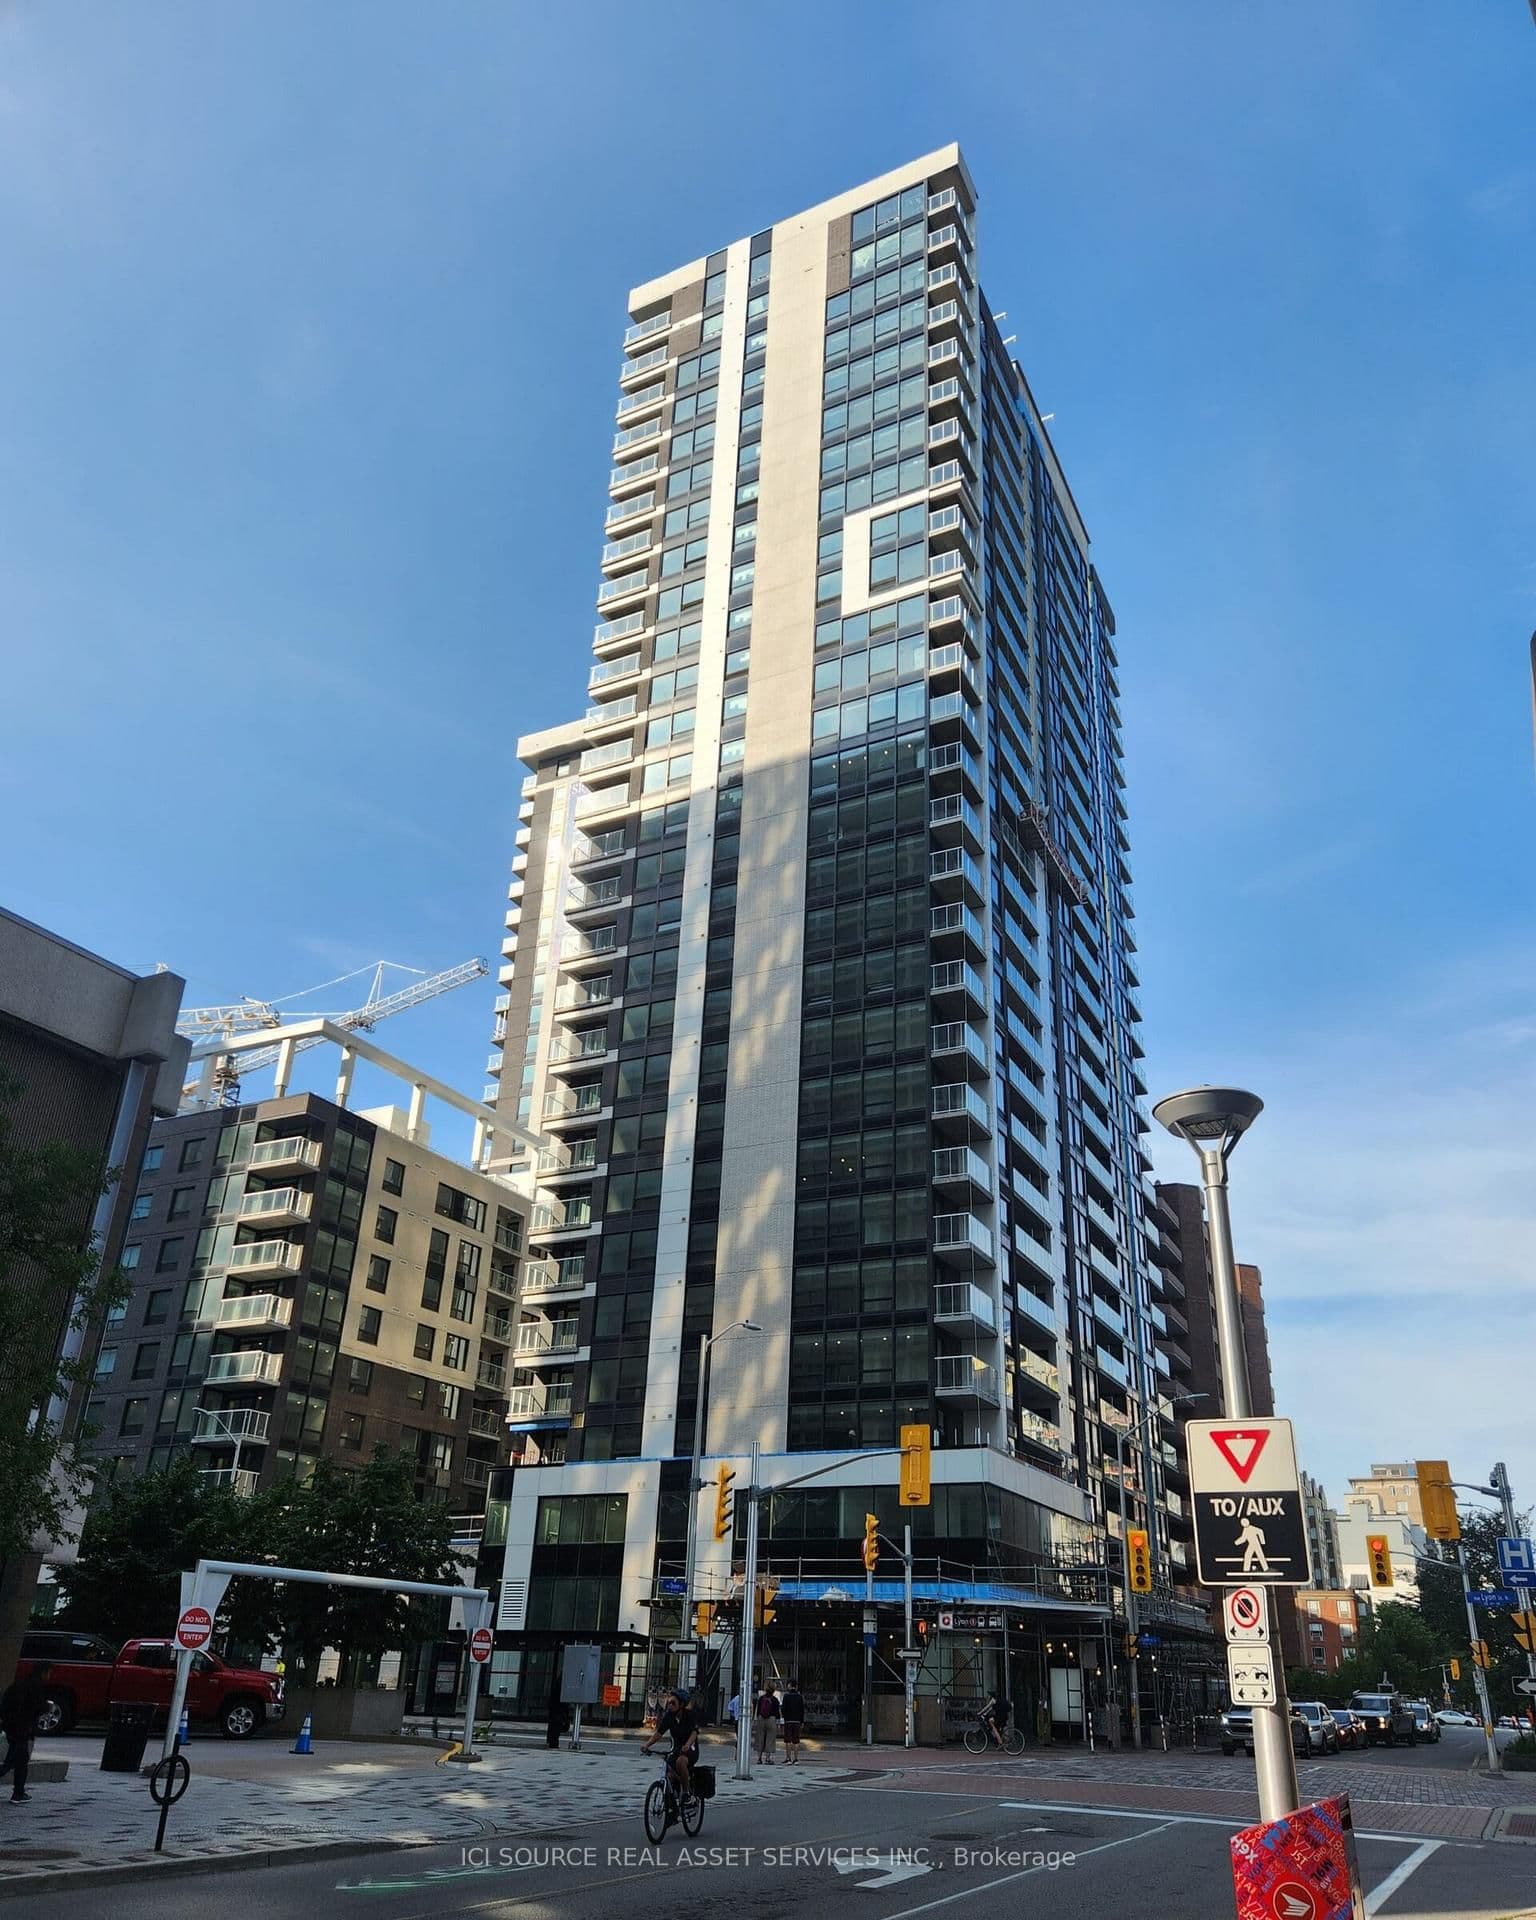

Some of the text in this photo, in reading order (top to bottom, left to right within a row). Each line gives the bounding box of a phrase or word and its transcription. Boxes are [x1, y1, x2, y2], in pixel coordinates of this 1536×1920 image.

[1208, 1496, 1286, 1518] TO/AUX
[1502, 1540, 1530, 1568] H
[184, 1615, 195, 1623] DO
[183, 1632, 204, 1641] ENTER
[1230, 1836, 1258, 1865] H9X
[1290, 1850, 1309, 1866] J5T
